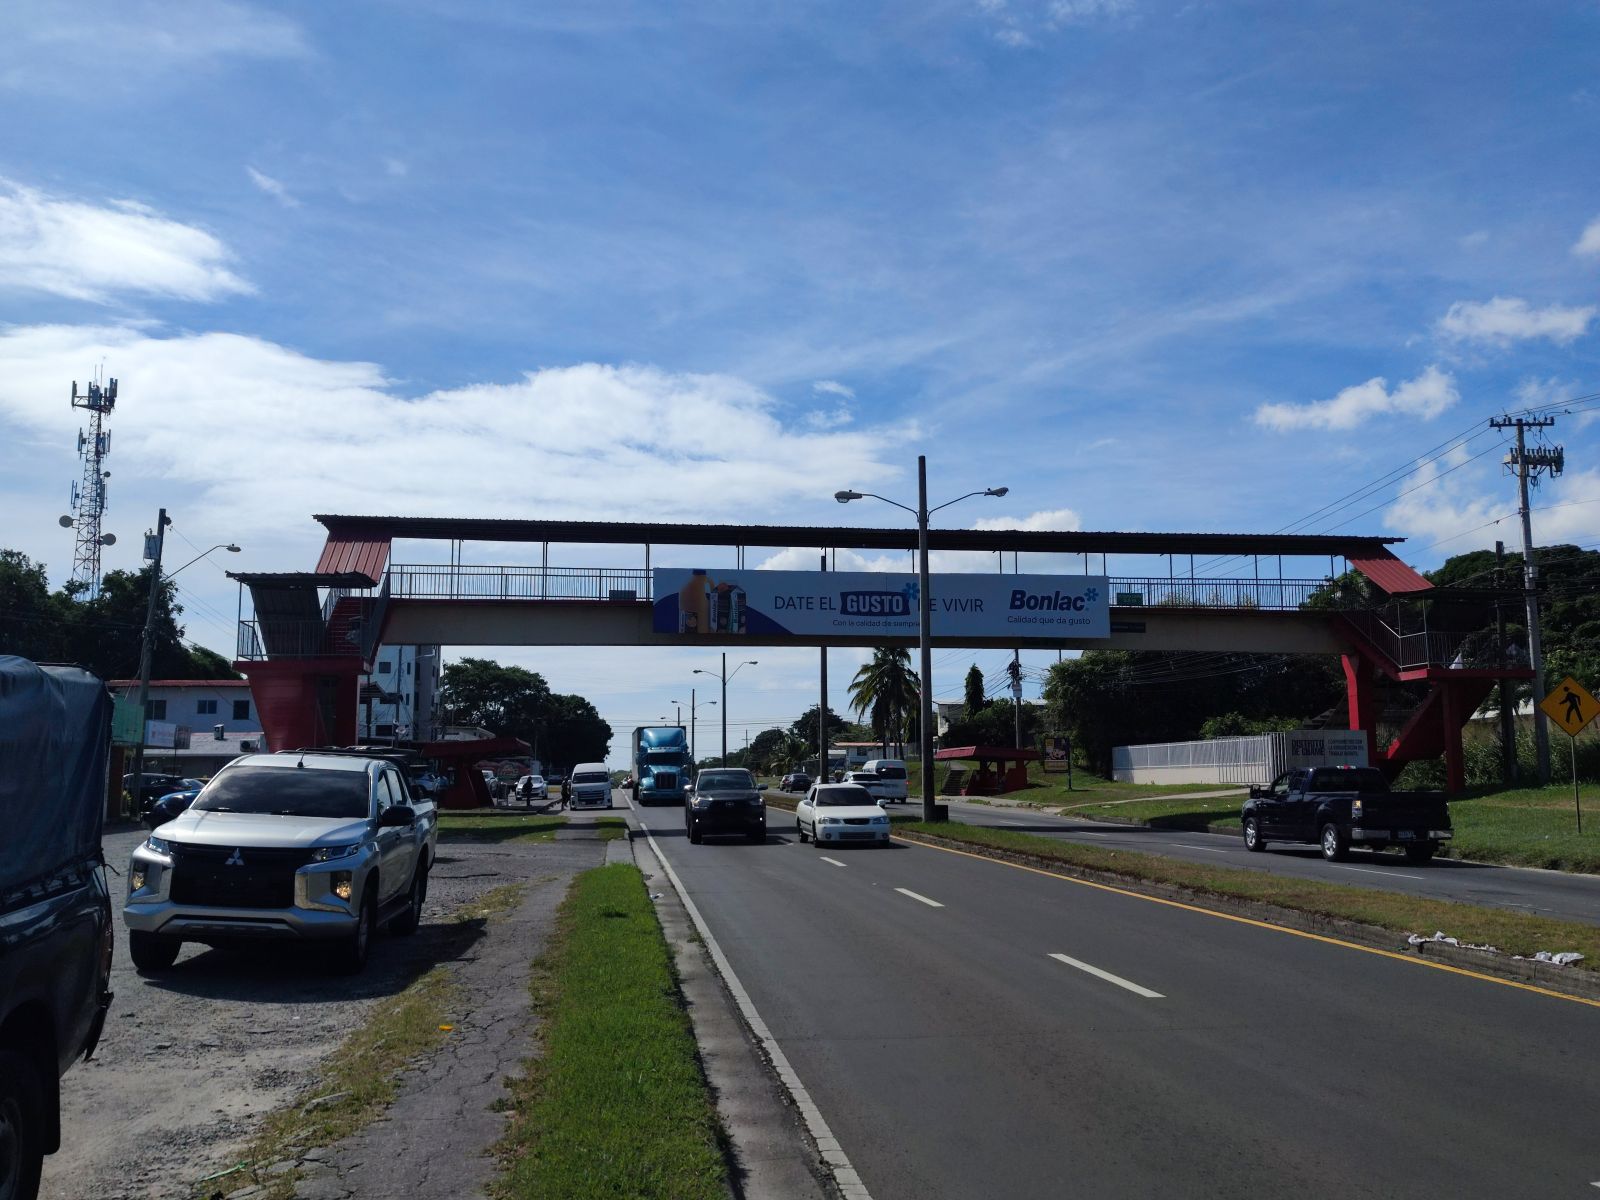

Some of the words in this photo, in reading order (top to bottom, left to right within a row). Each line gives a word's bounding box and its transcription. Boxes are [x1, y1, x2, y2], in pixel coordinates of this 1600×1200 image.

[774, 595, 814, 611] DATE
[819, 596, 836, 611] EL
[846, 594, 904, 613] GUSTO
[918, 598, 937, 612] E
[942, 598, 984, 613] VIVIR
[1009, 589, 1086, 611] Bonlac
[832, 619, 847, 627] Con
[855, 619, 880, 627] calidad
[1007, 615, 1038, 624] Calidad
[1038, 616, 1054, 626] que
[1056, 616, 1067, 625] da
[1068, 616, 1091, 626] gusto
